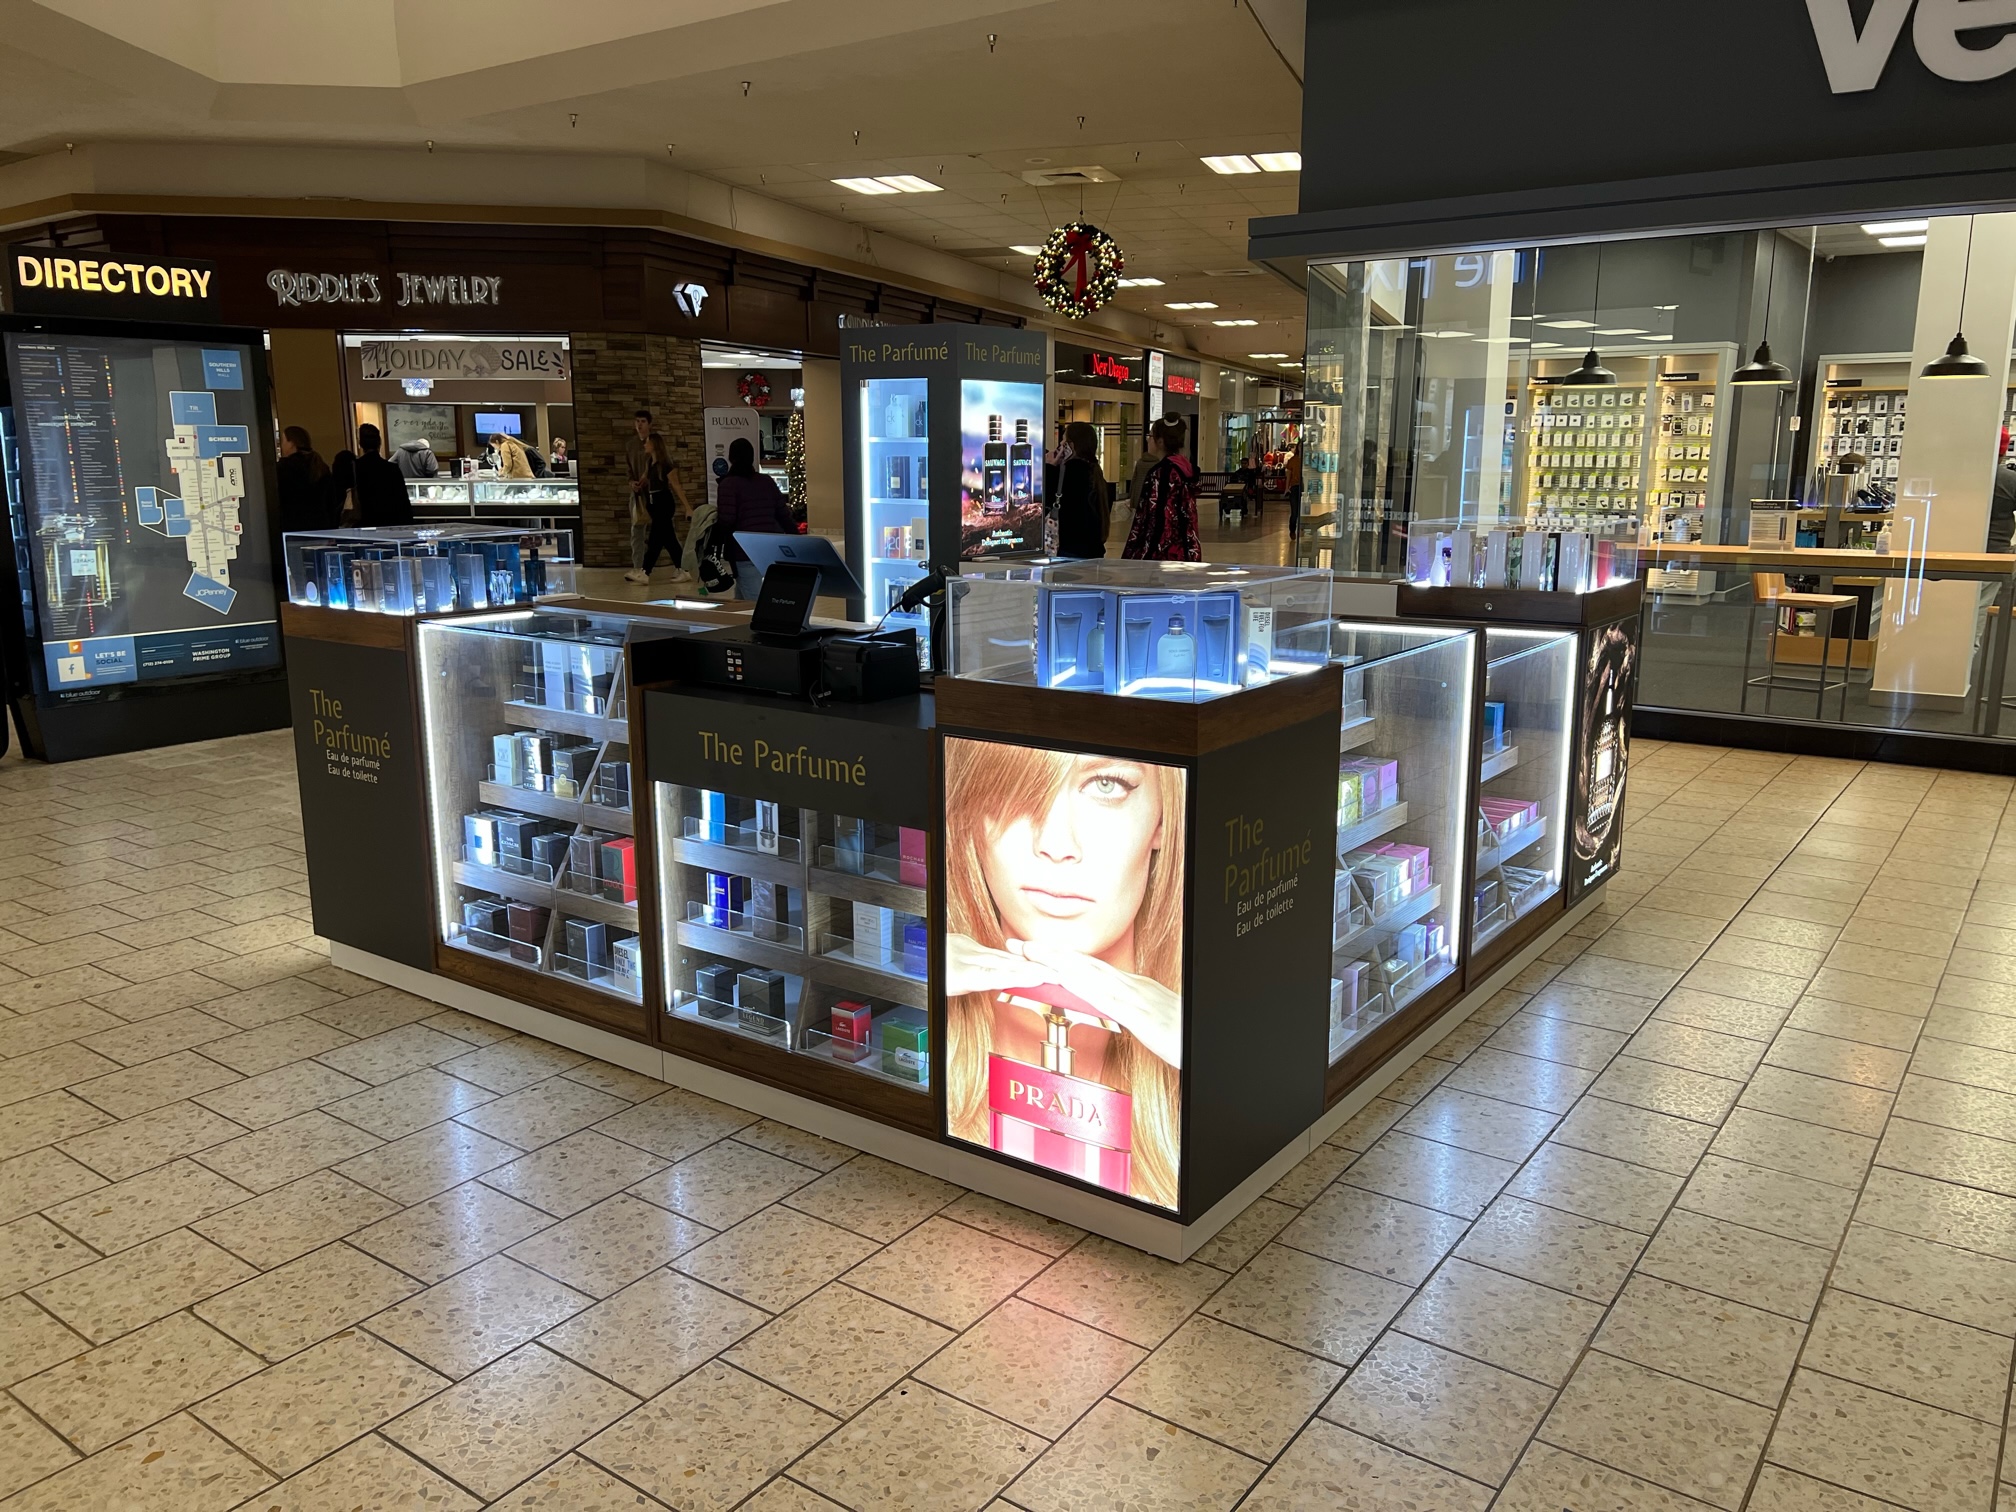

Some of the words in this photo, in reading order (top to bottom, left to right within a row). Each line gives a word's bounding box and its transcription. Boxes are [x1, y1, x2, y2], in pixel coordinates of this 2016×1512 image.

[17, 255, 211, 298] DIRECTORY
[266, 269, 381, 306] RIDDLE'S
[396, 272, 500, 307] JEWELRY
[375, 347, 465, 371] HOLIDAY
[501, 349, 550, 371] SALE
[849, 345, 876, 363] The
[882, 341, 949, 362] Parfumé
[965, 342, 987, 362] The
[992, 344, 1041, 366] Parfumé
[1107, 356, 1129, 384] Dragon
[712, 417, 749, 426] BULOVA
[195, 588, 227, 597] JCPenney
[95, 651, 114, 659] LET'S
[192, 648, 230, 656] WASHINGTON
[309, 689, 343, 719] The
[314, 719, 391, 759] Parfumé
[326, 749, 339, 761] Eau
[340, 752, 350, 764] de
[351, 756, 381, 770] parfumé
[698, 731, 743, 765] The
[754, 739, 866, 786] Parfumé
[328, 763, 341, 776] Eau
[342, 767, 351, 778] de
[352, 769, 378, 784] toilette
[1225, 814, 1264, 857] The
[1225, 828, 1312, 905] Parfumé
[1237, 900, 1252, 917] Eau
[1254, 891, 1265, 907] de
[1266, 872, 1299, 905] parfumé
[1236, 920, 1251, 938] Eau
[1253, 912, 1264, 928] de
[1266, 898, 1294, 921] toilette
[742, 1013, 765, 1025] LEGEND
[1009, 1079, 1107, 1130] PRADA
